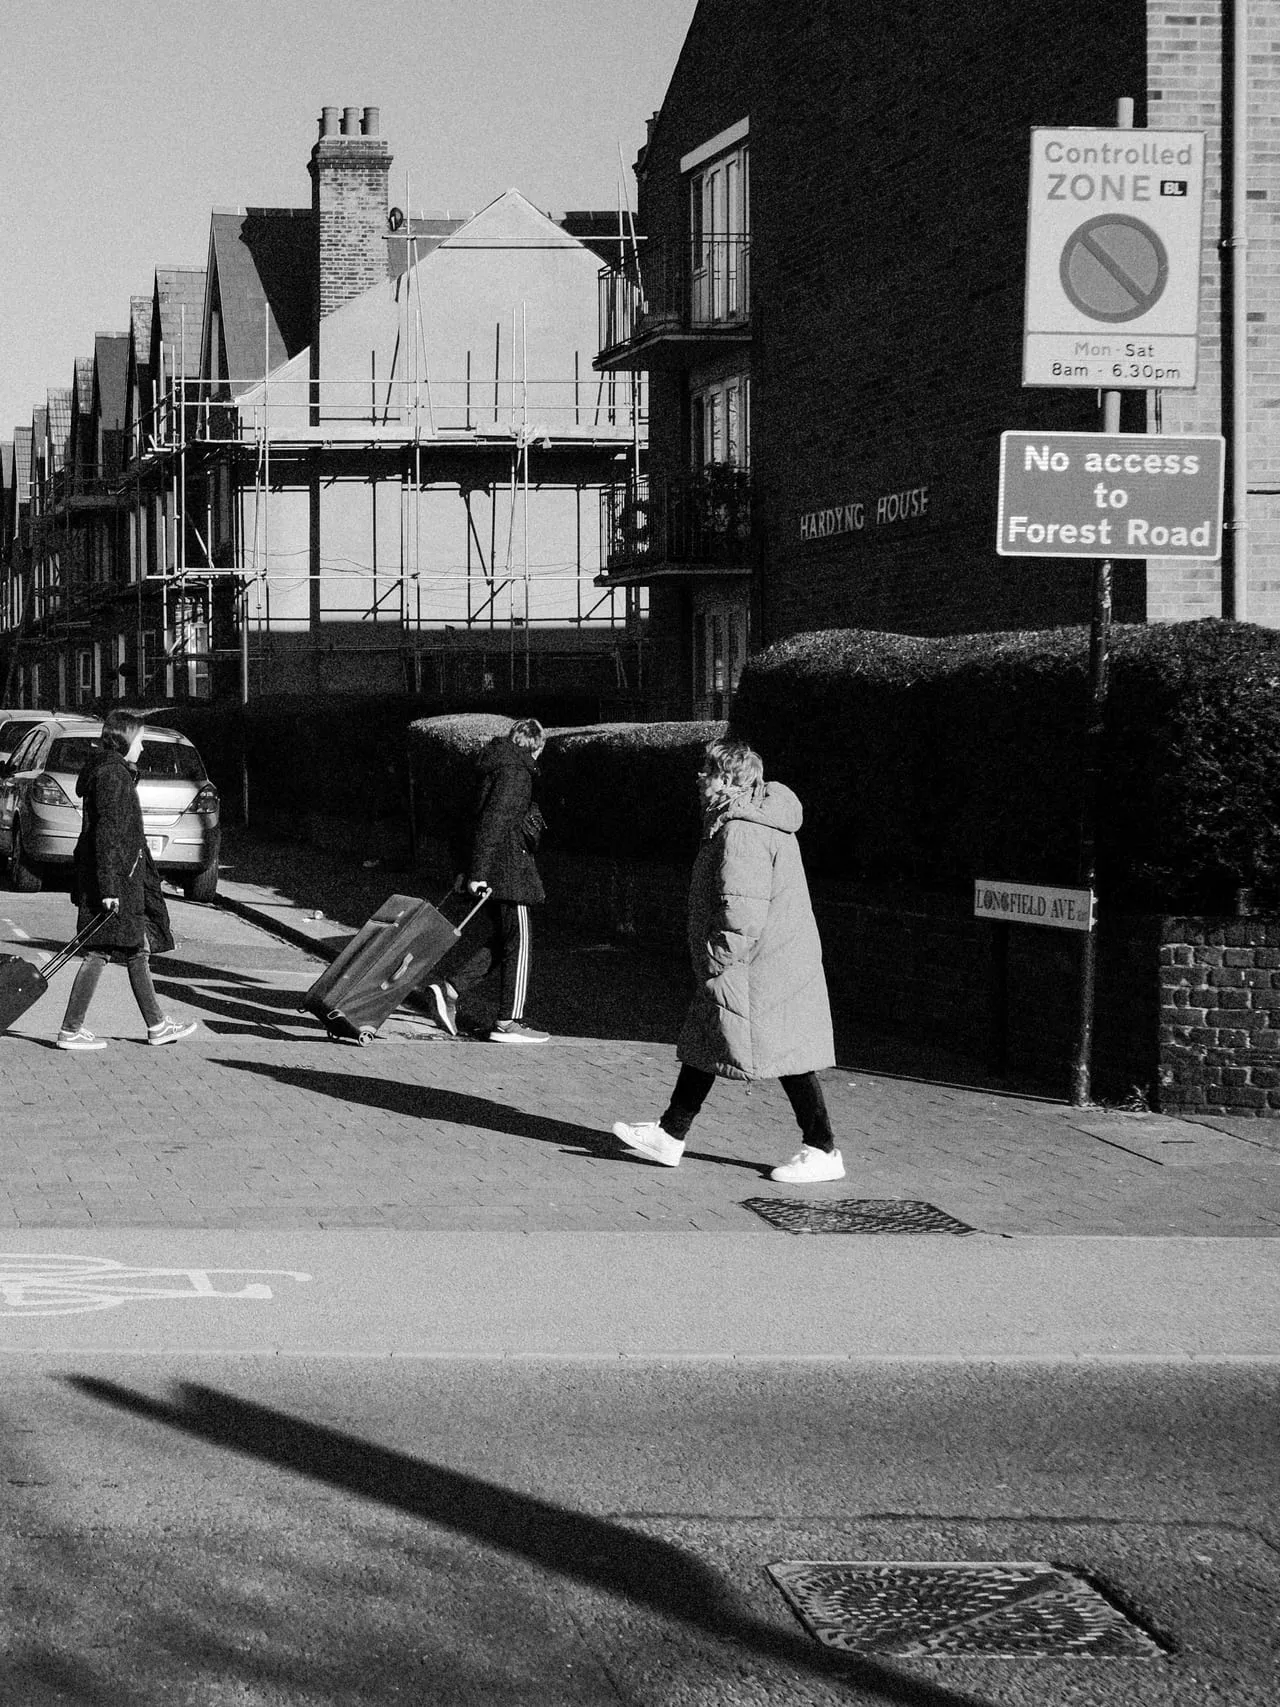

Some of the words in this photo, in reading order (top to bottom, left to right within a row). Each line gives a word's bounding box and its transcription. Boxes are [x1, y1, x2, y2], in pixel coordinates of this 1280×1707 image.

[1044, 141, 1192, 165] Controlled
[1047, 173, 1151, 201] ZONE
[1163, 182, 1183, 195] BL
[1074, 341, 1111, 357] Mon
[1125, 343, 1154, 357] Sat
[1052, 362, 1088, 377] 8am
[1112, 363, 1180, 379] 6.30pm
[1024, 445, 1069, 471] No
[1084, 453, 1199, 474] access
[1094, 482, 1128, 508] to
[800, 503, 864, 540] HARDYNG
[877, 486, 928, 524] HOUSE
[1008, 516, 1112, 545] Forest
[1127, 519, 1210, 547] Road
[976, 889, 1046, 917] LONGFIELD
[1050, 898, 1075, 920] AVE
